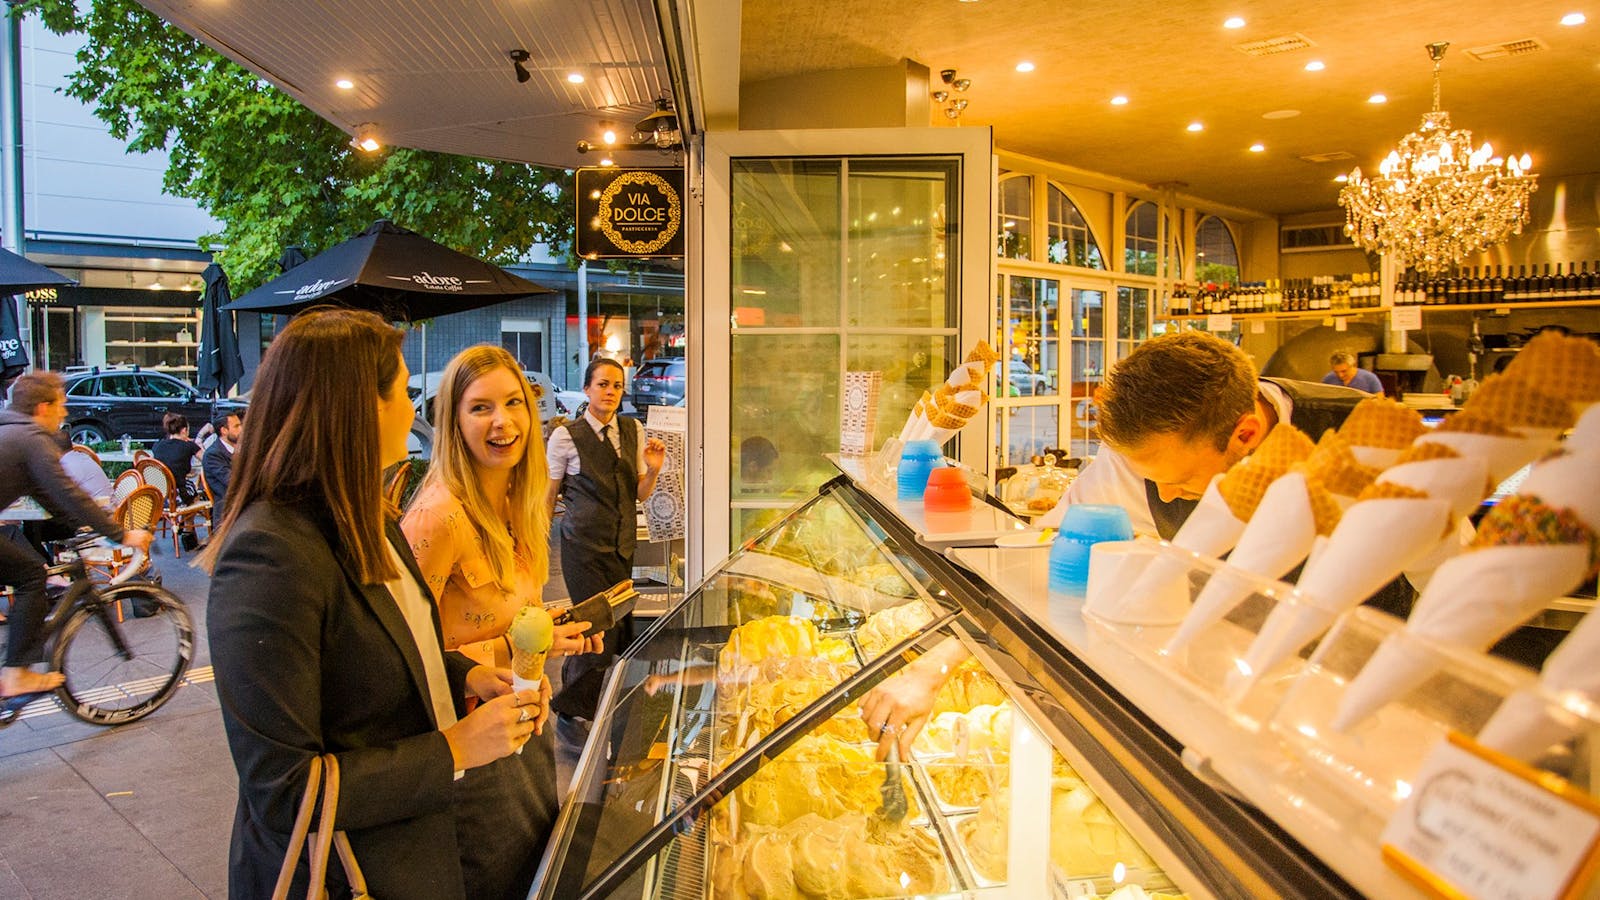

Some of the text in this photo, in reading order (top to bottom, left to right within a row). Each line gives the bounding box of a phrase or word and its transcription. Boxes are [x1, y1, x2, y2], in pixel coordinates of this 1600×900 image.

[627, 192, 651, 205] VIA
[614, 207, 666, 222] DOLCE
[412, 271, 462, 287] adore
